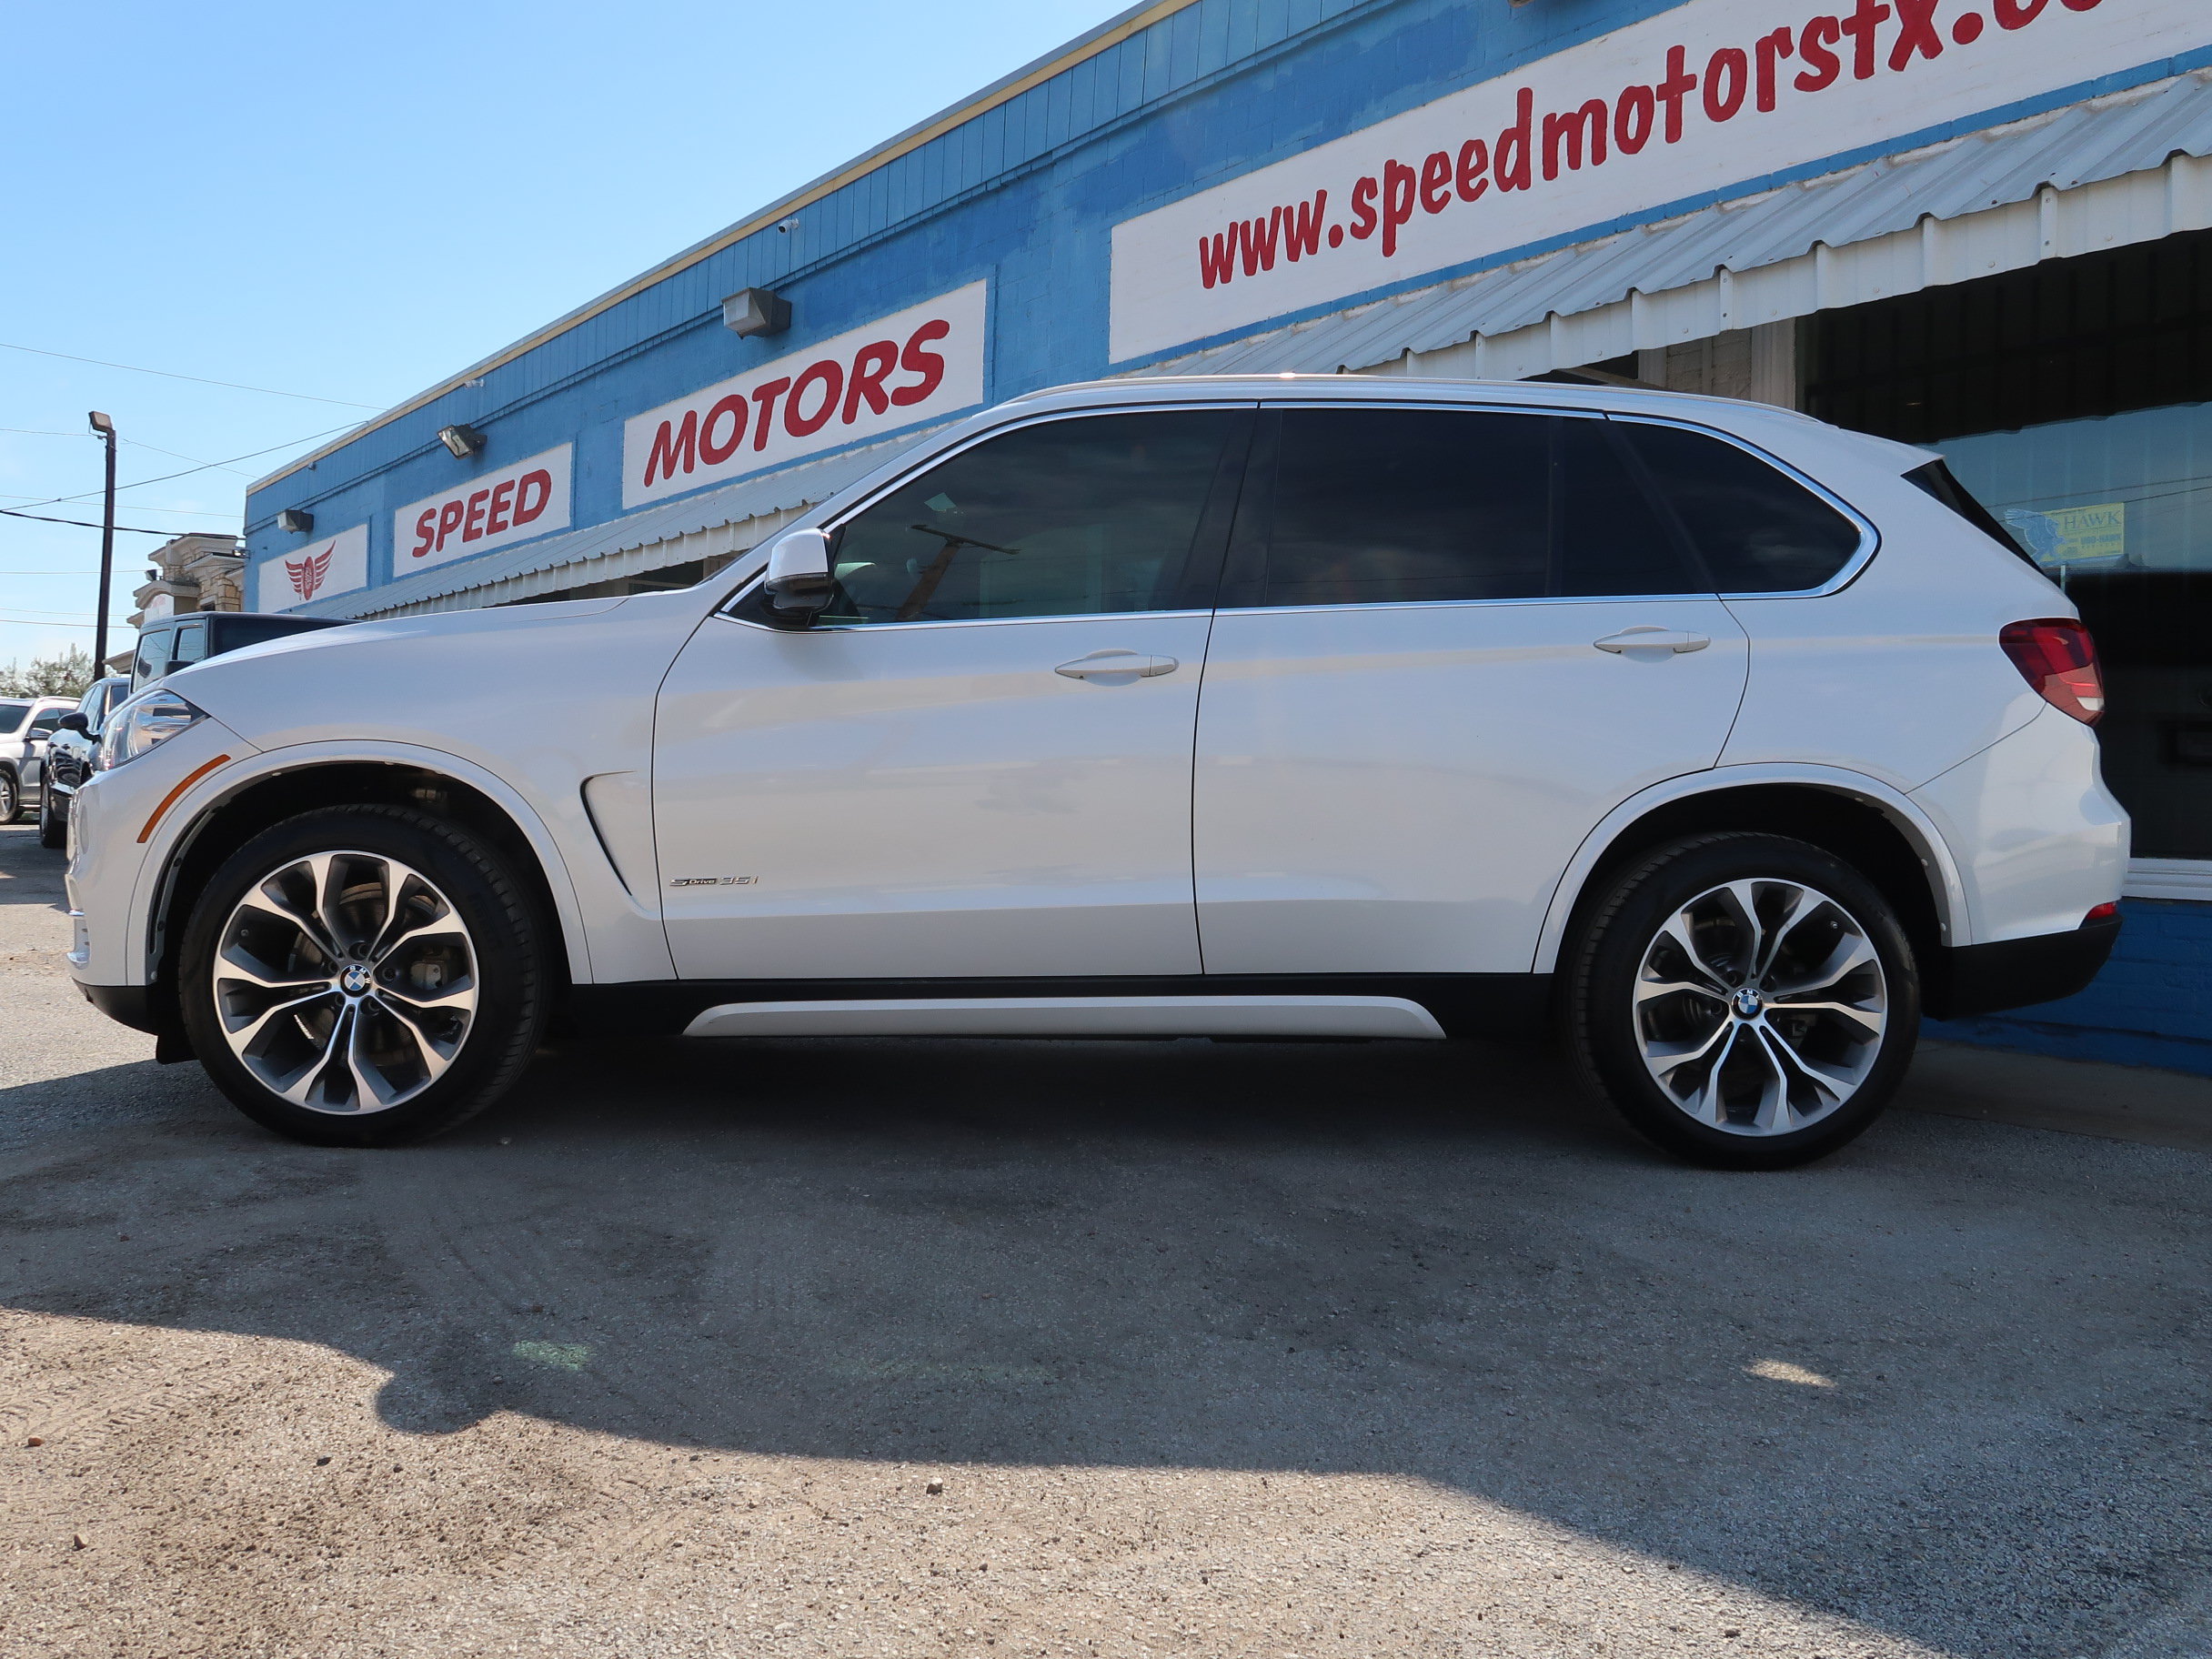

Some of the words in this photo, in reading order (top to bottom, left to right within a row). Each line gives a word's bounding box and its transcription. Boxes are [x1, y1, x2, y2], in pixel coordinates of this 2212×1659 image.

[1201, 0, 2101, 288] www.speedmotorstx.
[413, 469, 551, 557] SPEED
[645, 319, 950, 486] MOTORS
[2064, 510, 2122, 528] HAWK
[349, 965, 371, 984] BMW
